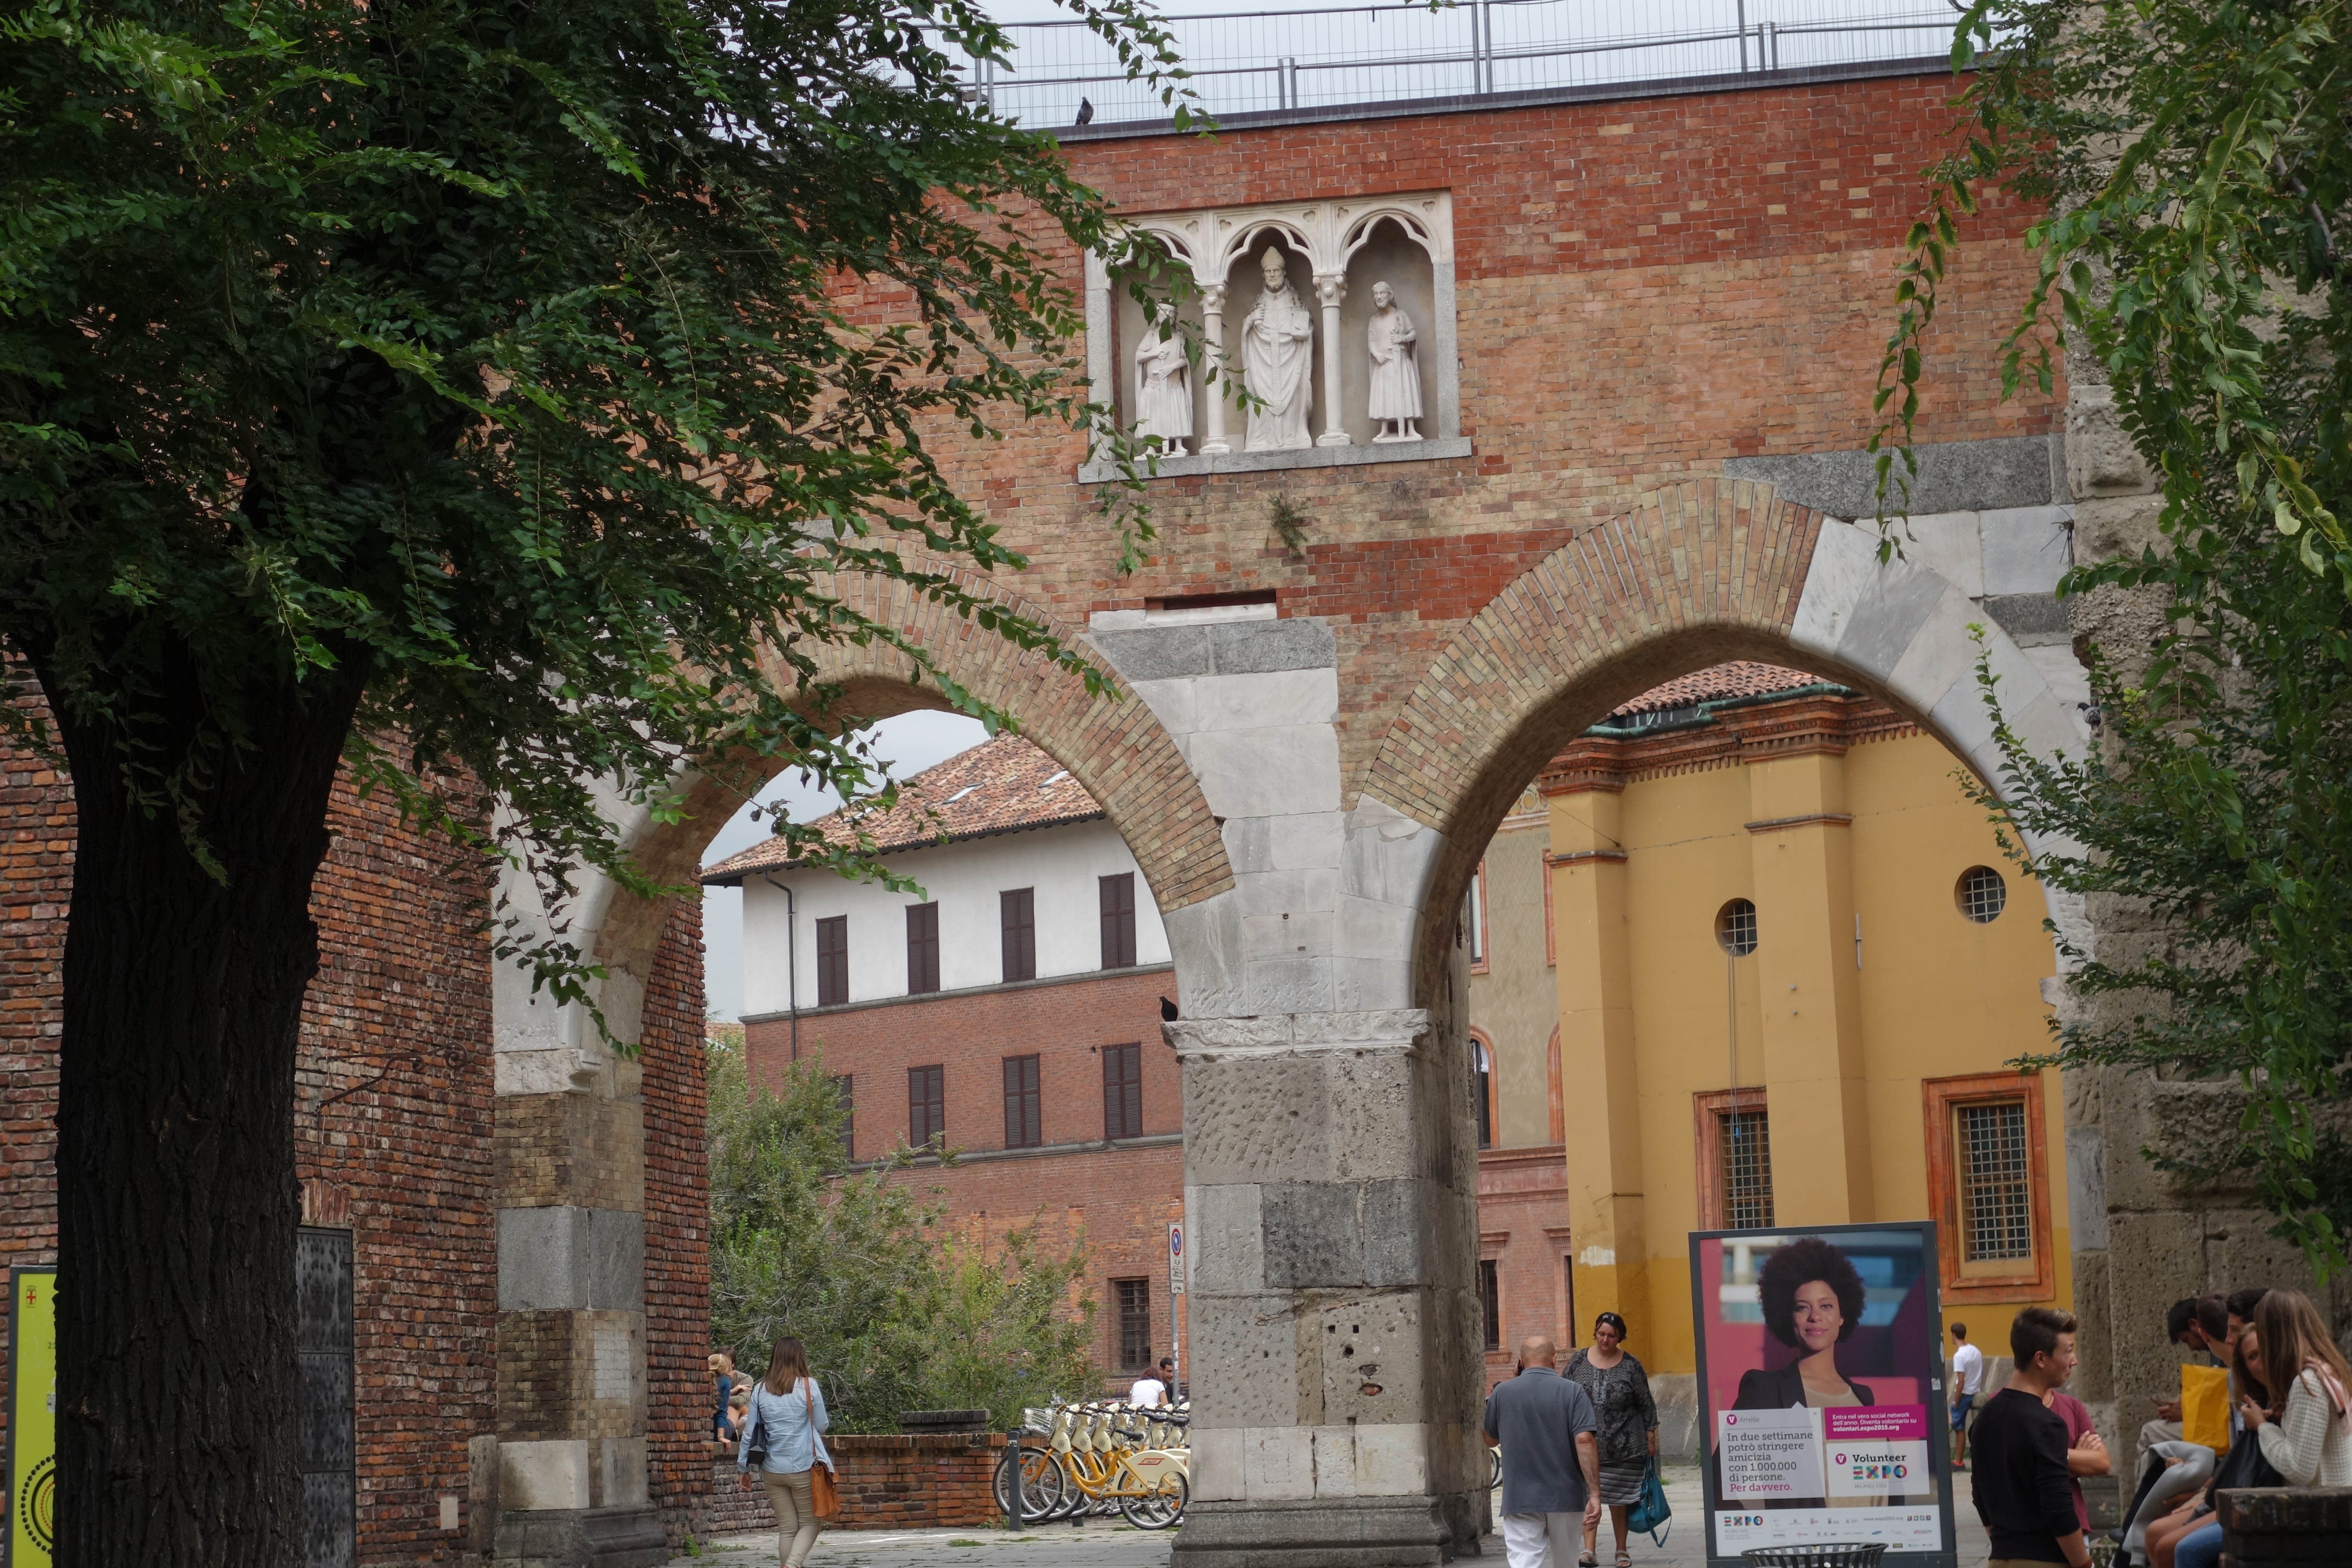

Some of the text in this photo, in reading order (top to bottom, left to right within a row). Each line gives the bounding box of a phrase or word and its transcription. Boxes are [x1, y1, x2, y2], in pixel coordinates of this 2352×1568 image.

[1727, 1431, 1813, 1441] In due settimane
[1728, 1442, 1804, 1453] potrò stringere
[1728, 1453, 1771, 1461] amicizia
[1852, 1454, 1906, 1462] Volunteer
[1750, 1461, 1797, 1471] 1.000.000
[1853, 1465, 1907, 1480] EXPO
[1730, 1473, 1785, 1483] di persone.
[1730, 1484, 1746, 1492] Per
[1724, 1516, 1763, 1527] EXPO
